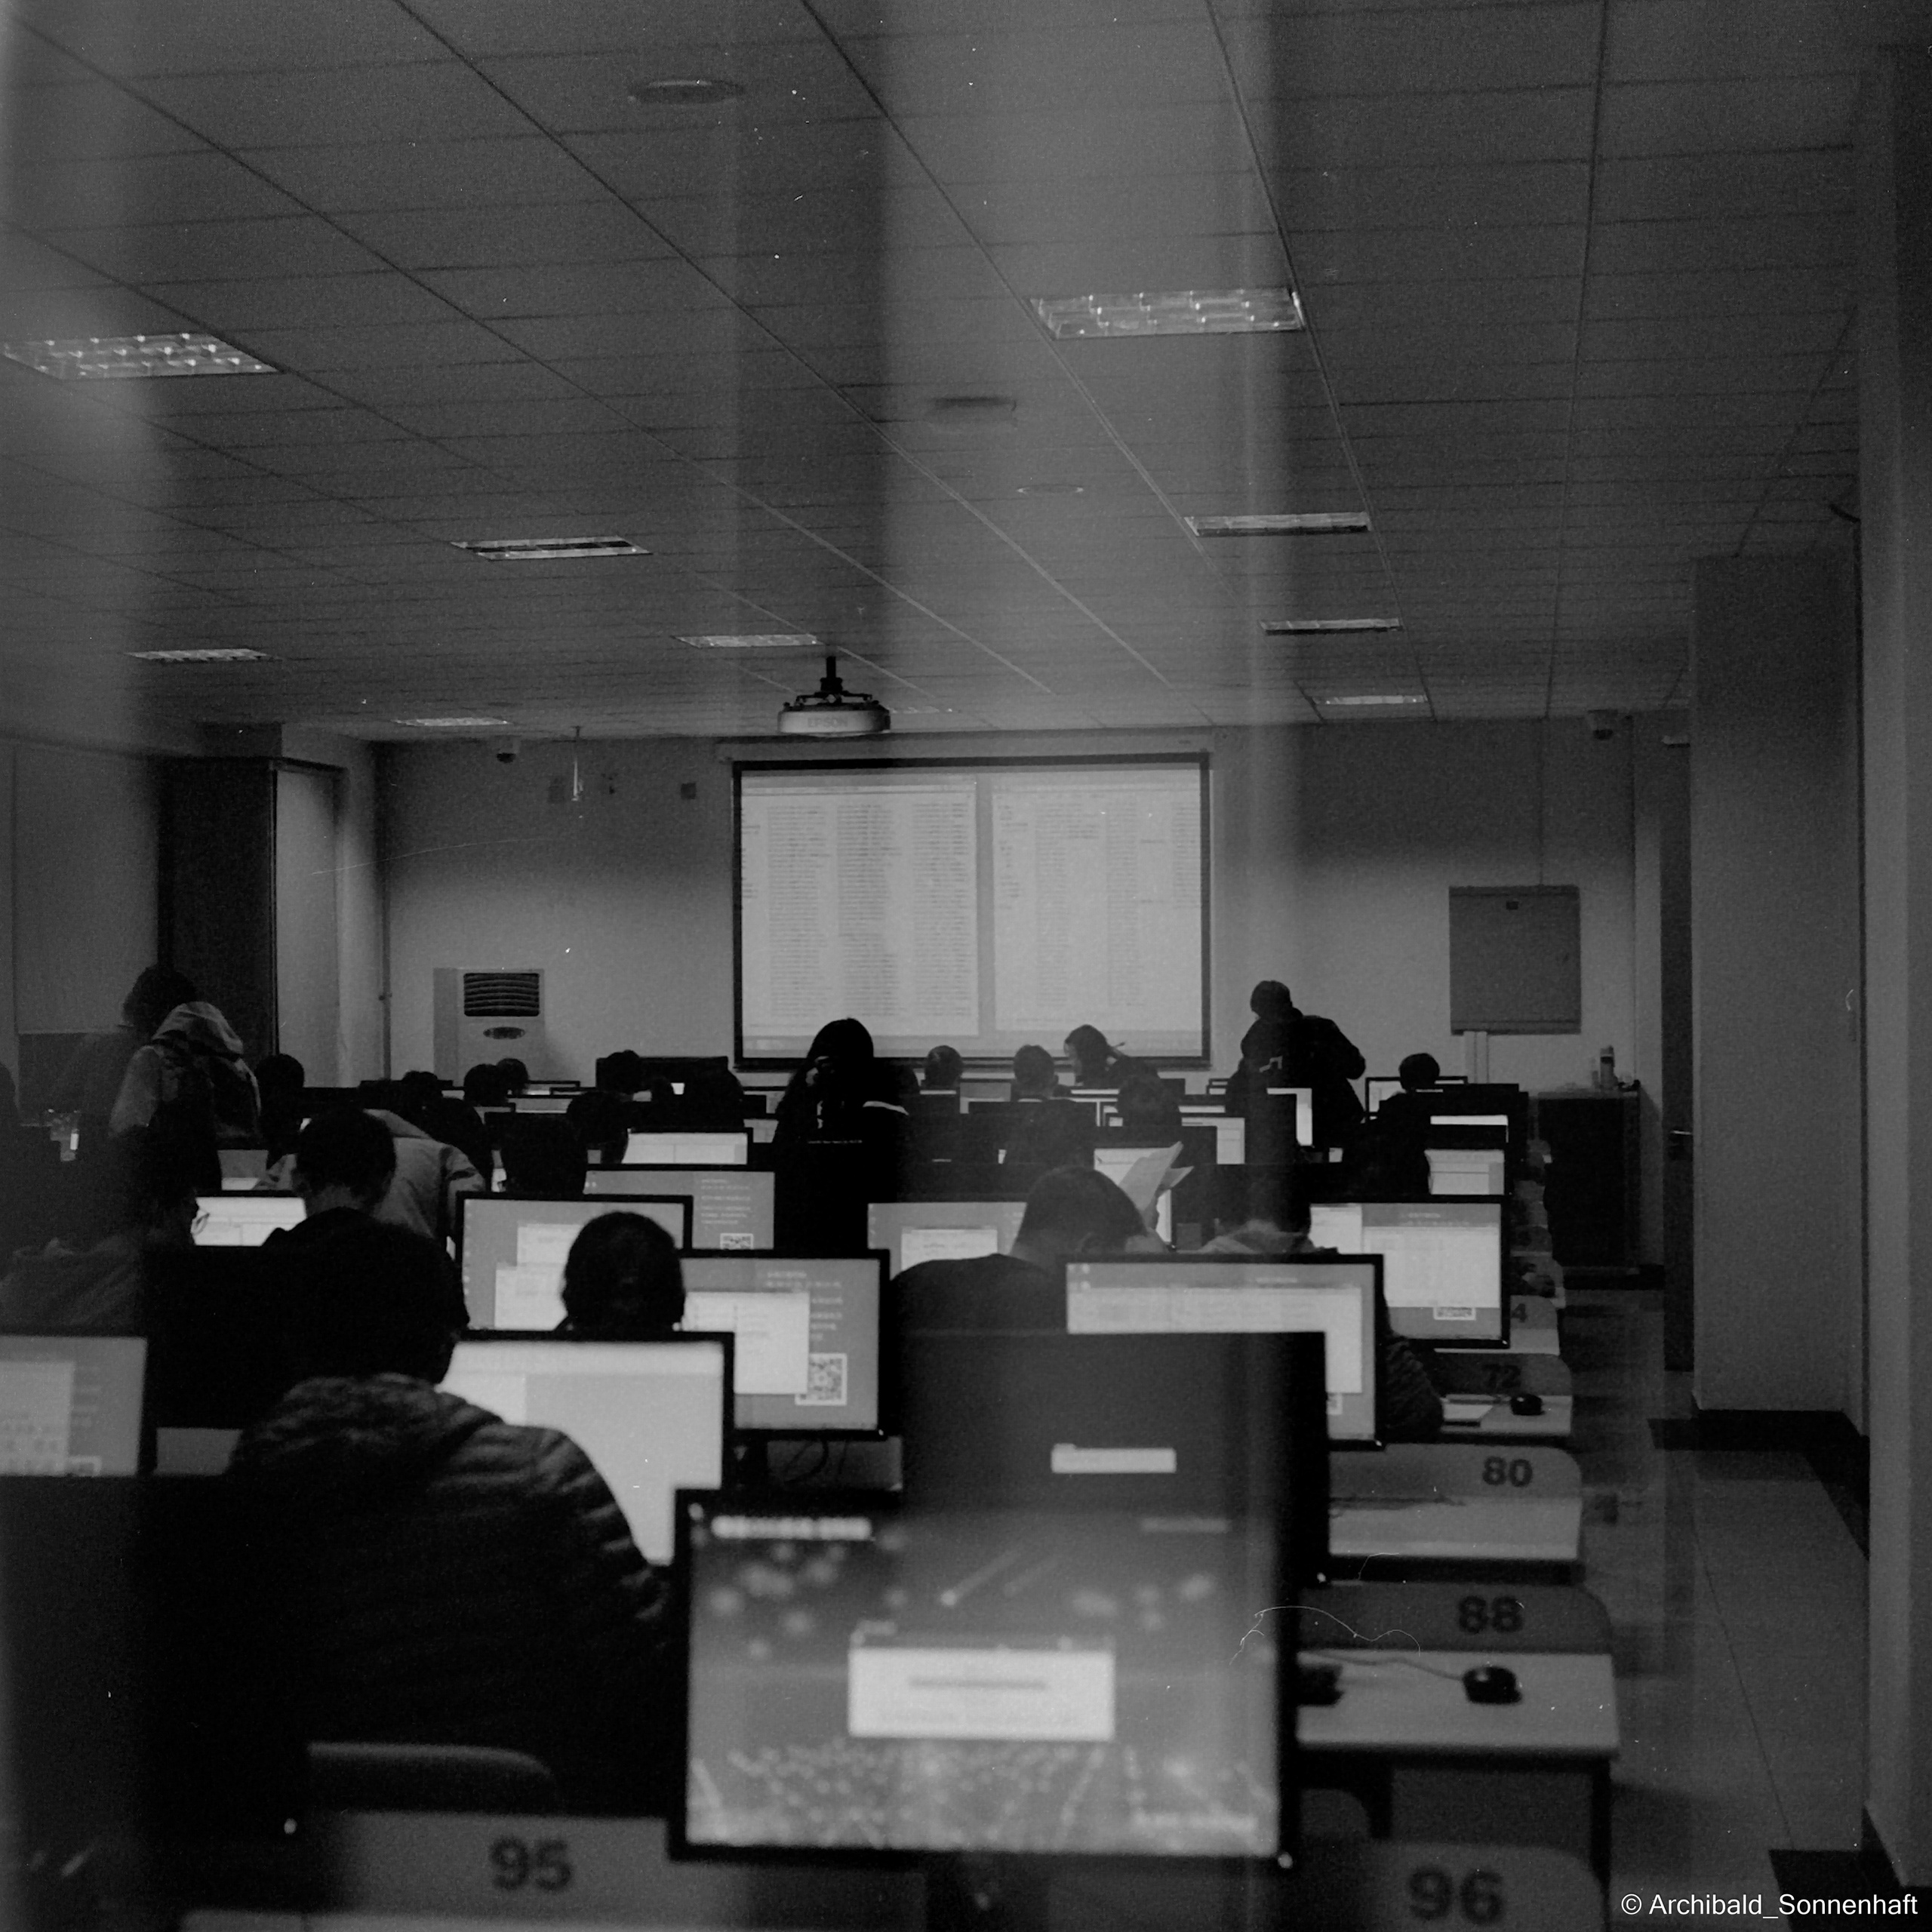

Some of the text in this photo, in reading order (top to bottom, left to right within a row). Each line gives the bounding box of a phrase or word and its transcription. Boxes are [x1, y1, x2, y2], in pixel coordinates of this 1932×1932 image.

[1510, 1303, 1527, 1323] 4
[1482, 1364, 1521, 1388] 72
[1482, 1455, 1533, 1487] 80
[1458, 1595, 1523, 1634] 88
[489, 1835, 571, 1892] 95
[1407, 1866, 1504, 1924] 96
